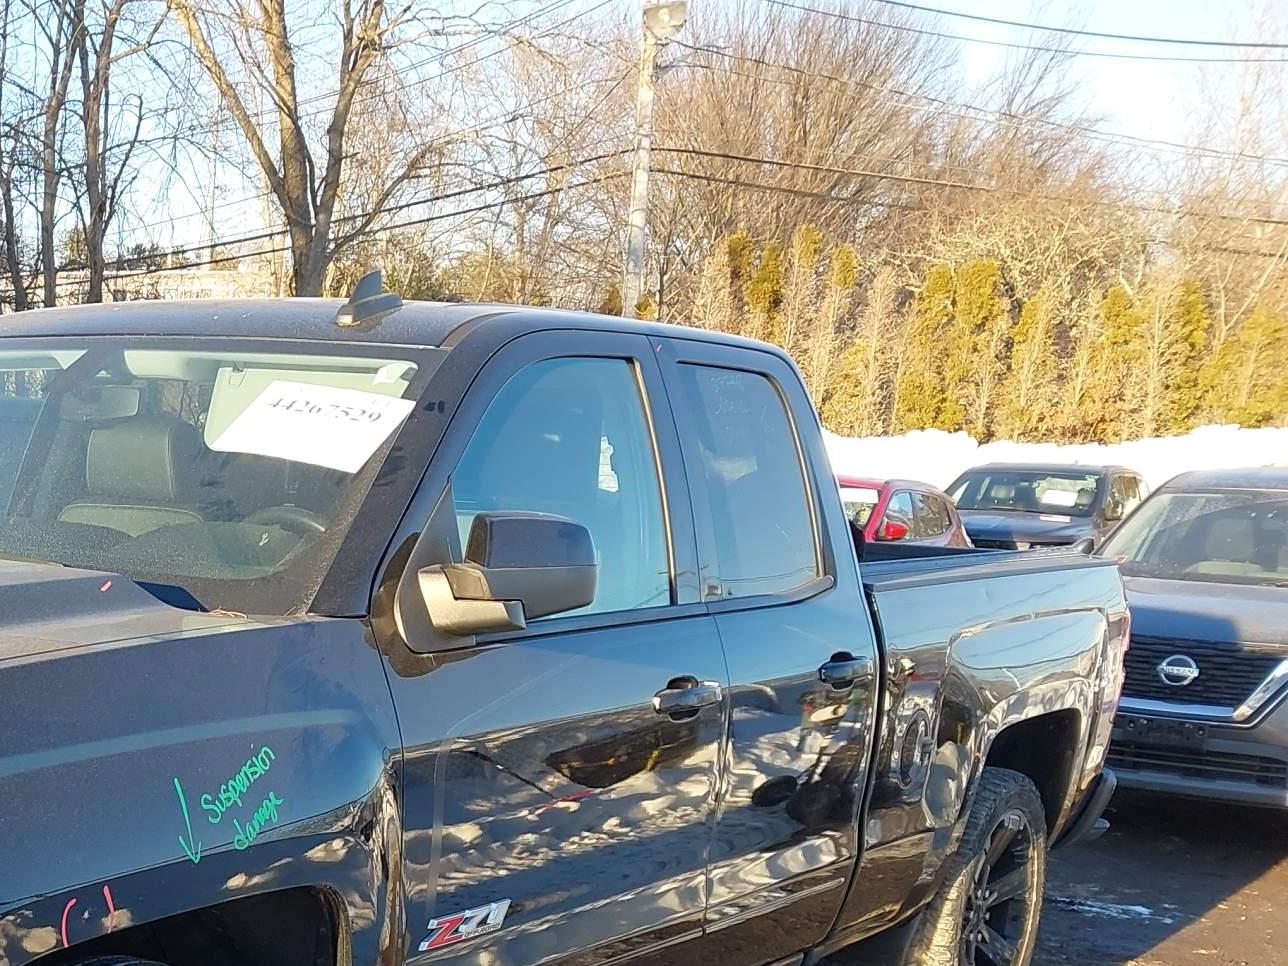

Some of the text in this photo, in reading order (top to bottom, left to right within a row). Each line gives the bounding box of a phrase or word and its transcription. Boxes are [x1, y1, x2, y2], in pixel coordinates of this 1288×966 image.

[266, 397, 382, 423] 44267529
[201, 746, 275, 824] Suspension
[418, 898, 511, 952] Z71
